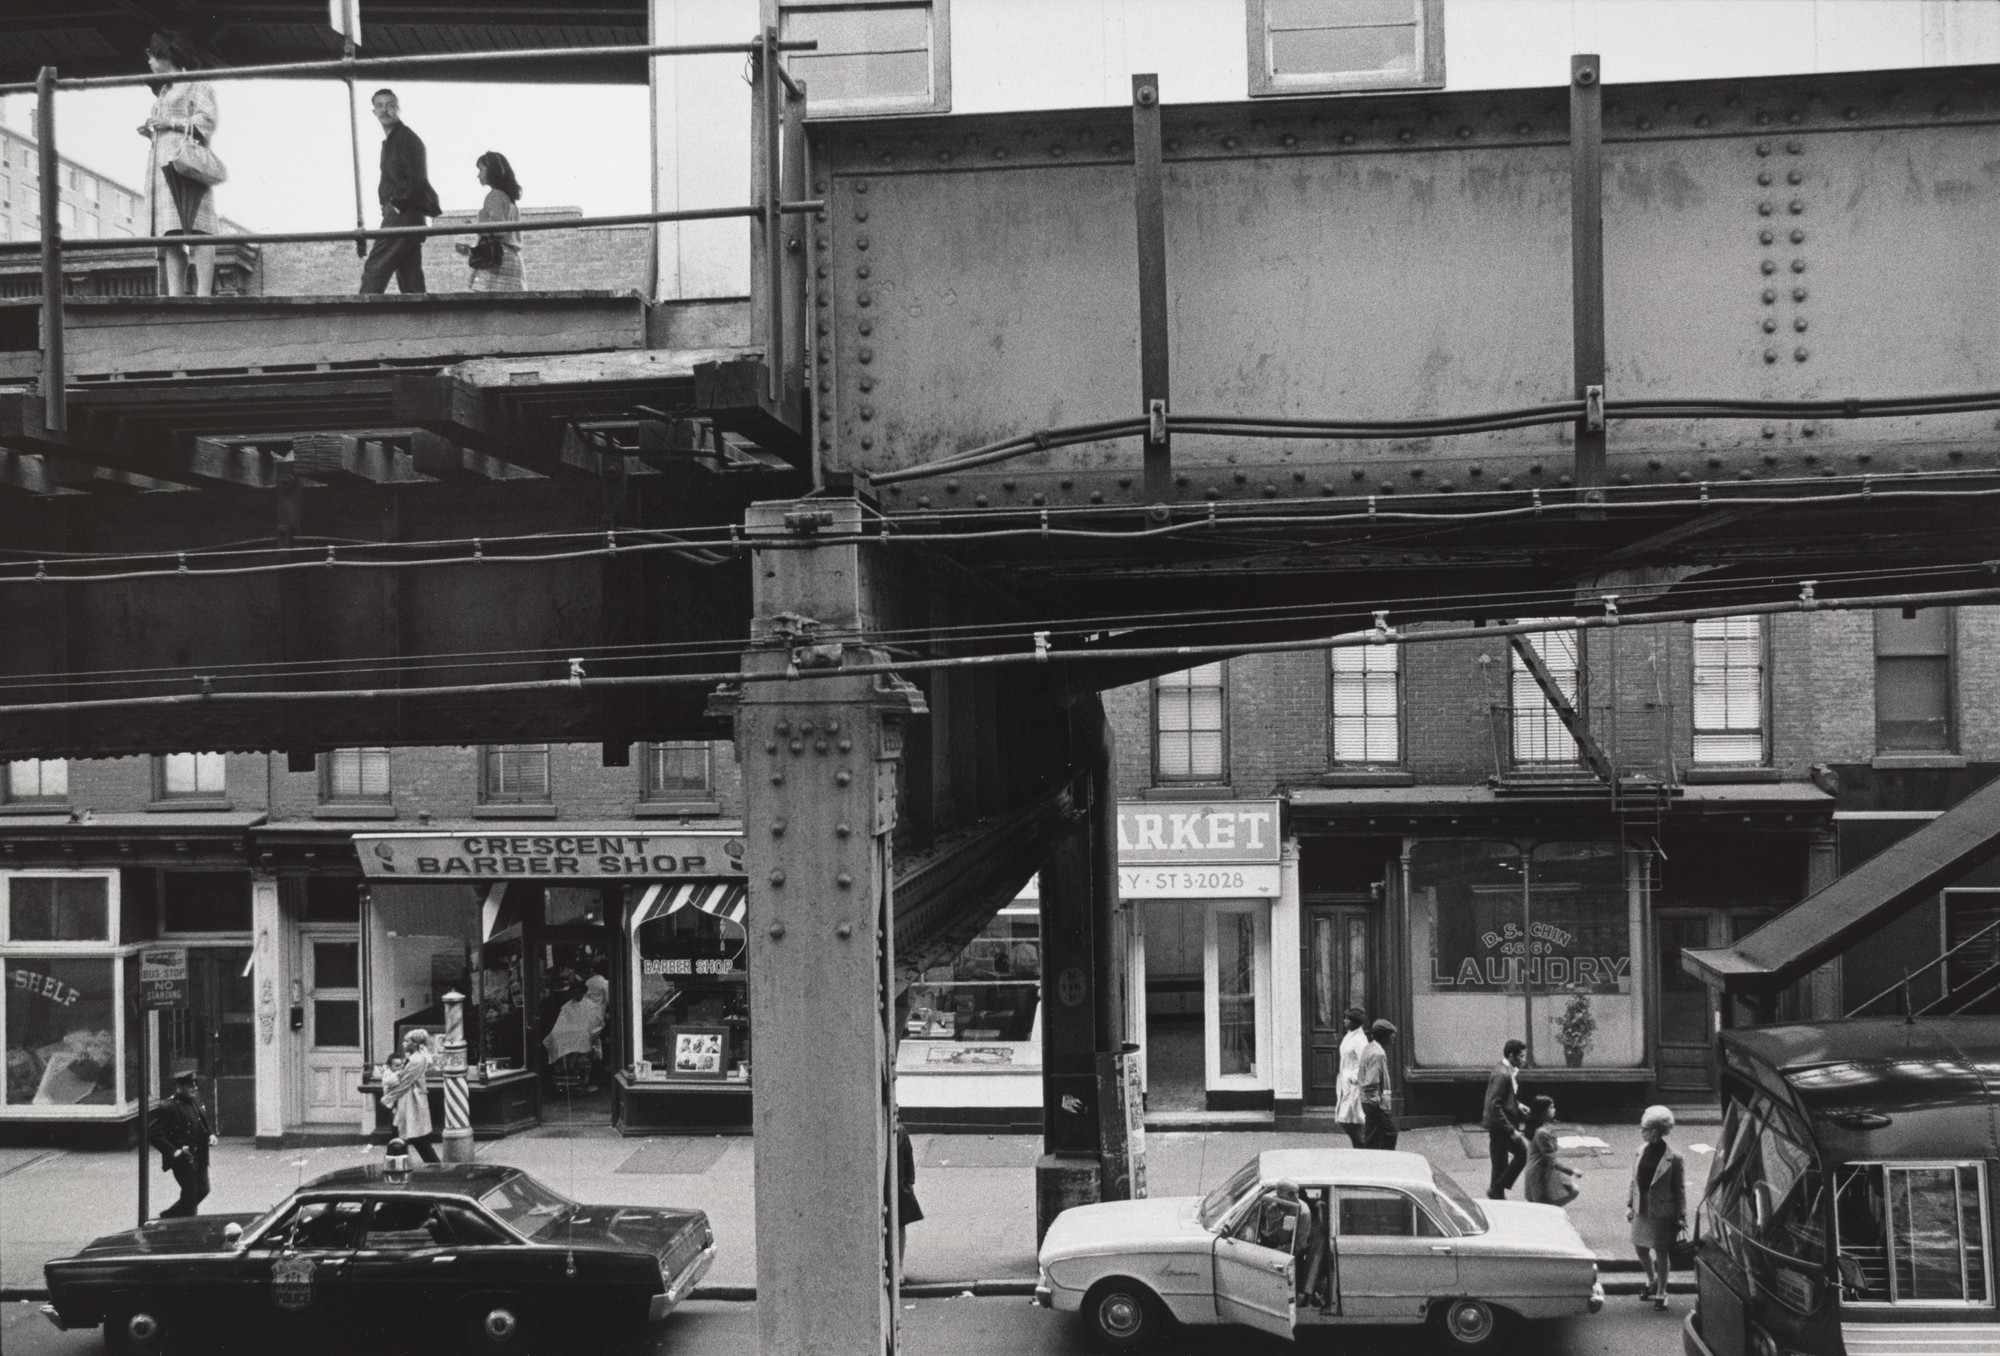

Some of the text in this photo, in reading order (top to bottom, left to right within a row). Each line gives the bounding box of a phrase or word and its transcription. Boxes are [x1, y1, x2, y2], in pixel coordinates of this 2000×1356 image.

[463, 837, 650, 855] CRESCENT
[416, 855, 706, 874] BARBER SHOP
[1156, 873, 1178, 889] ST
[1530, 922, 1572, 947] CHIN
[143, 968, 185, 979] BUS STOP
[644, 959, 733, 974] BARBER SHOP
[1430, 956, 1631, 985] LAUNDRY
[15, 970, 80, 1006] SHELF
[154, 980, 174, 991] NO
[146, 990, 182, 1000] STANDING
[276, 1292, 311, 1304] POLICE
